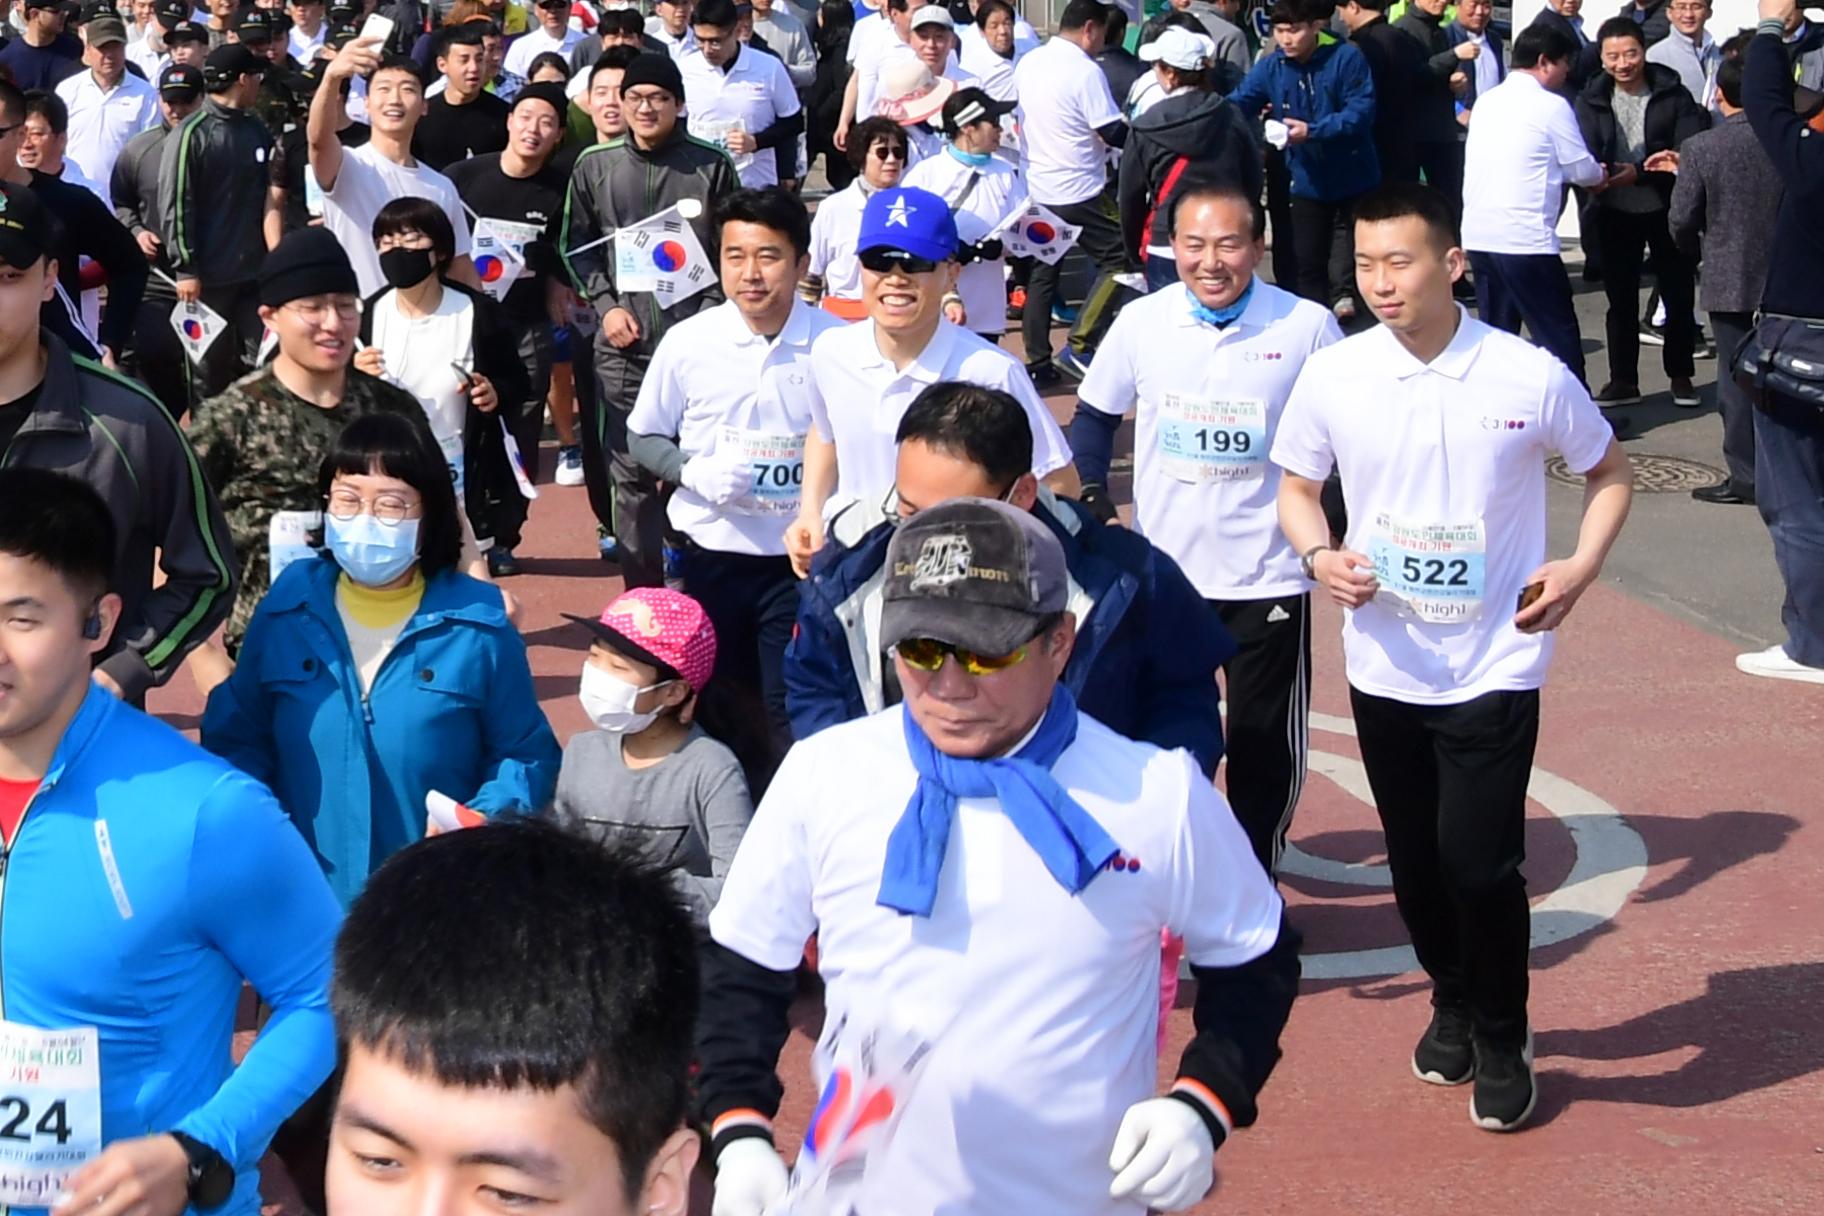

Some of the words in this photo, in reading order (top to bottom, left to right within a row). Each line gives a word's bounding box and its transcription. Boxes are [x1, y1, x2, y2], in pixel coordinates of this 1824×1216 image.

[1194, 428, 1251, 453] 199
[753, 462, 804, 486] 700
[1402, 555, 1469, 586] 522
